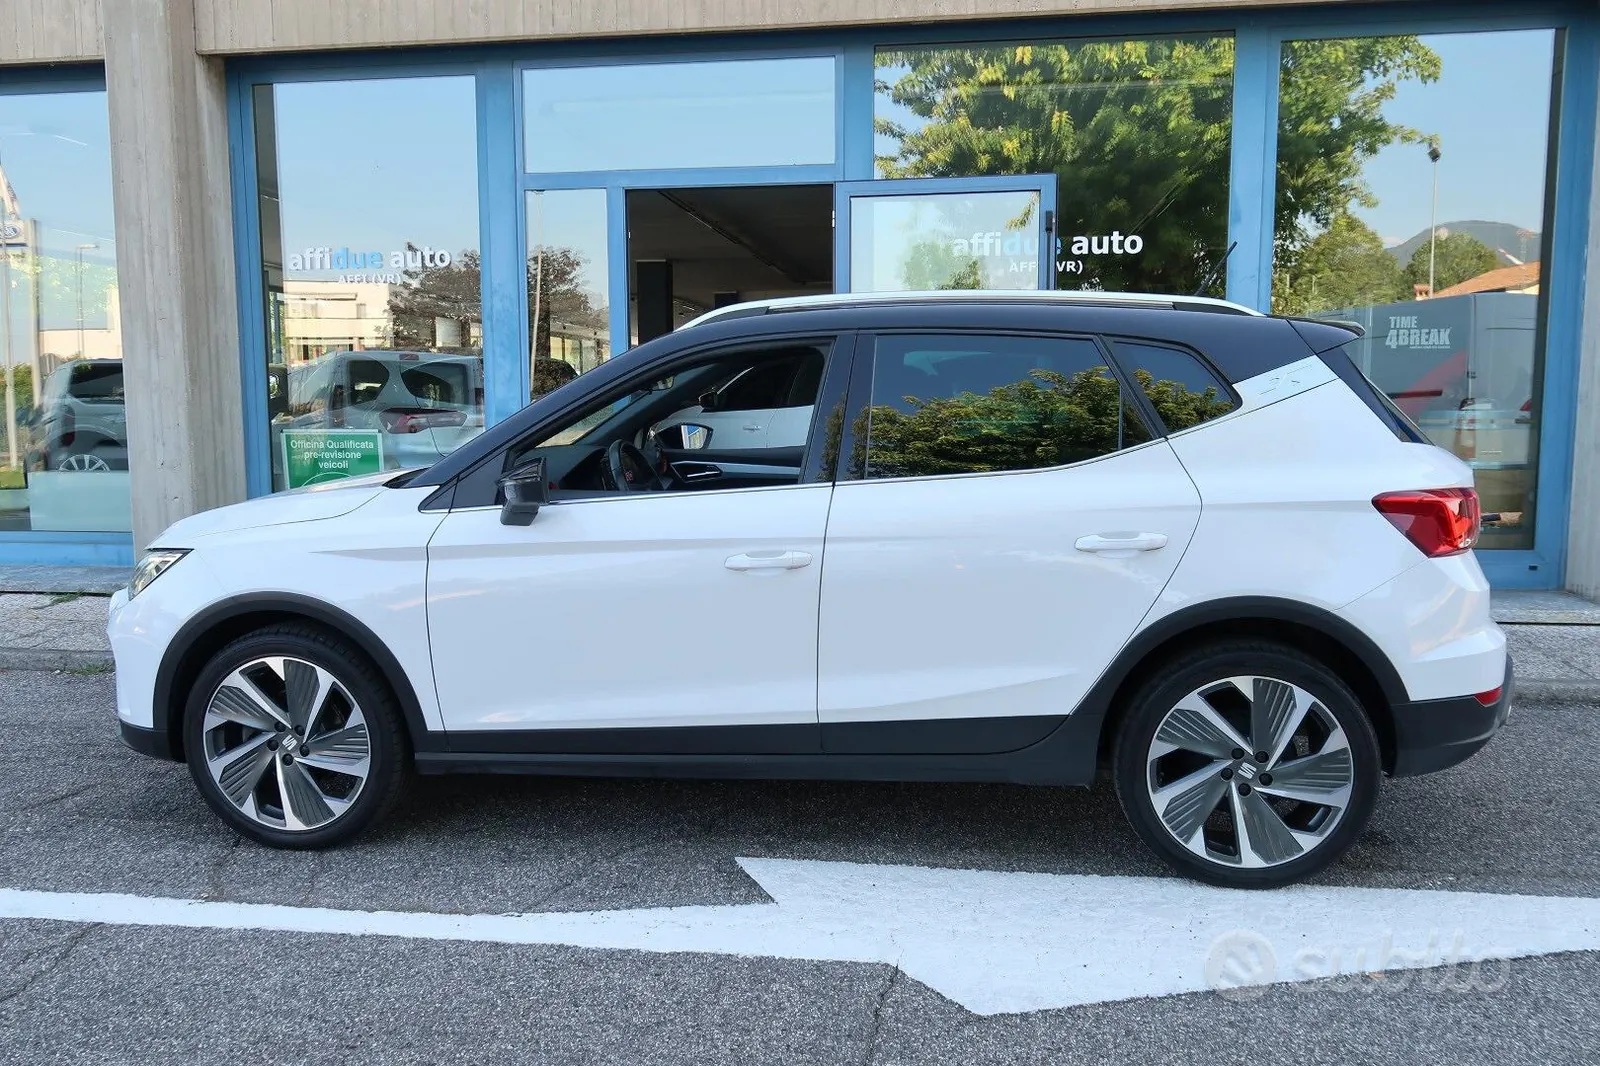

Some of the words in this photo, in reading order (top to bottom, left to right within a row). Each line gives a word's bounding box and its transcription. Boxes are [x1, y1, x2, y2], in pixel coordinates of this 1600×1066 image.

[952, 231, 1062, 256] affidu
[1071, 231, 1143, 255] auto
[289, 247, 383, 270] affidue
[389, 246, 451, 268] auto
[1009, 261, 1039, 272] AFF
[1056, 260, 1083, 275] VR)
[372, 273, 401, 286] (VR)
[1389, 316, 1418, 328] TIME
[1385, 328, 1451, 349] 4BREAK
[290, 440, 325, 449] Officina
[326, 440, 374, 449] Qualificata
[304, 450, 362, 460] pre-revisione
[318, 460, 349, 469] veicoli
